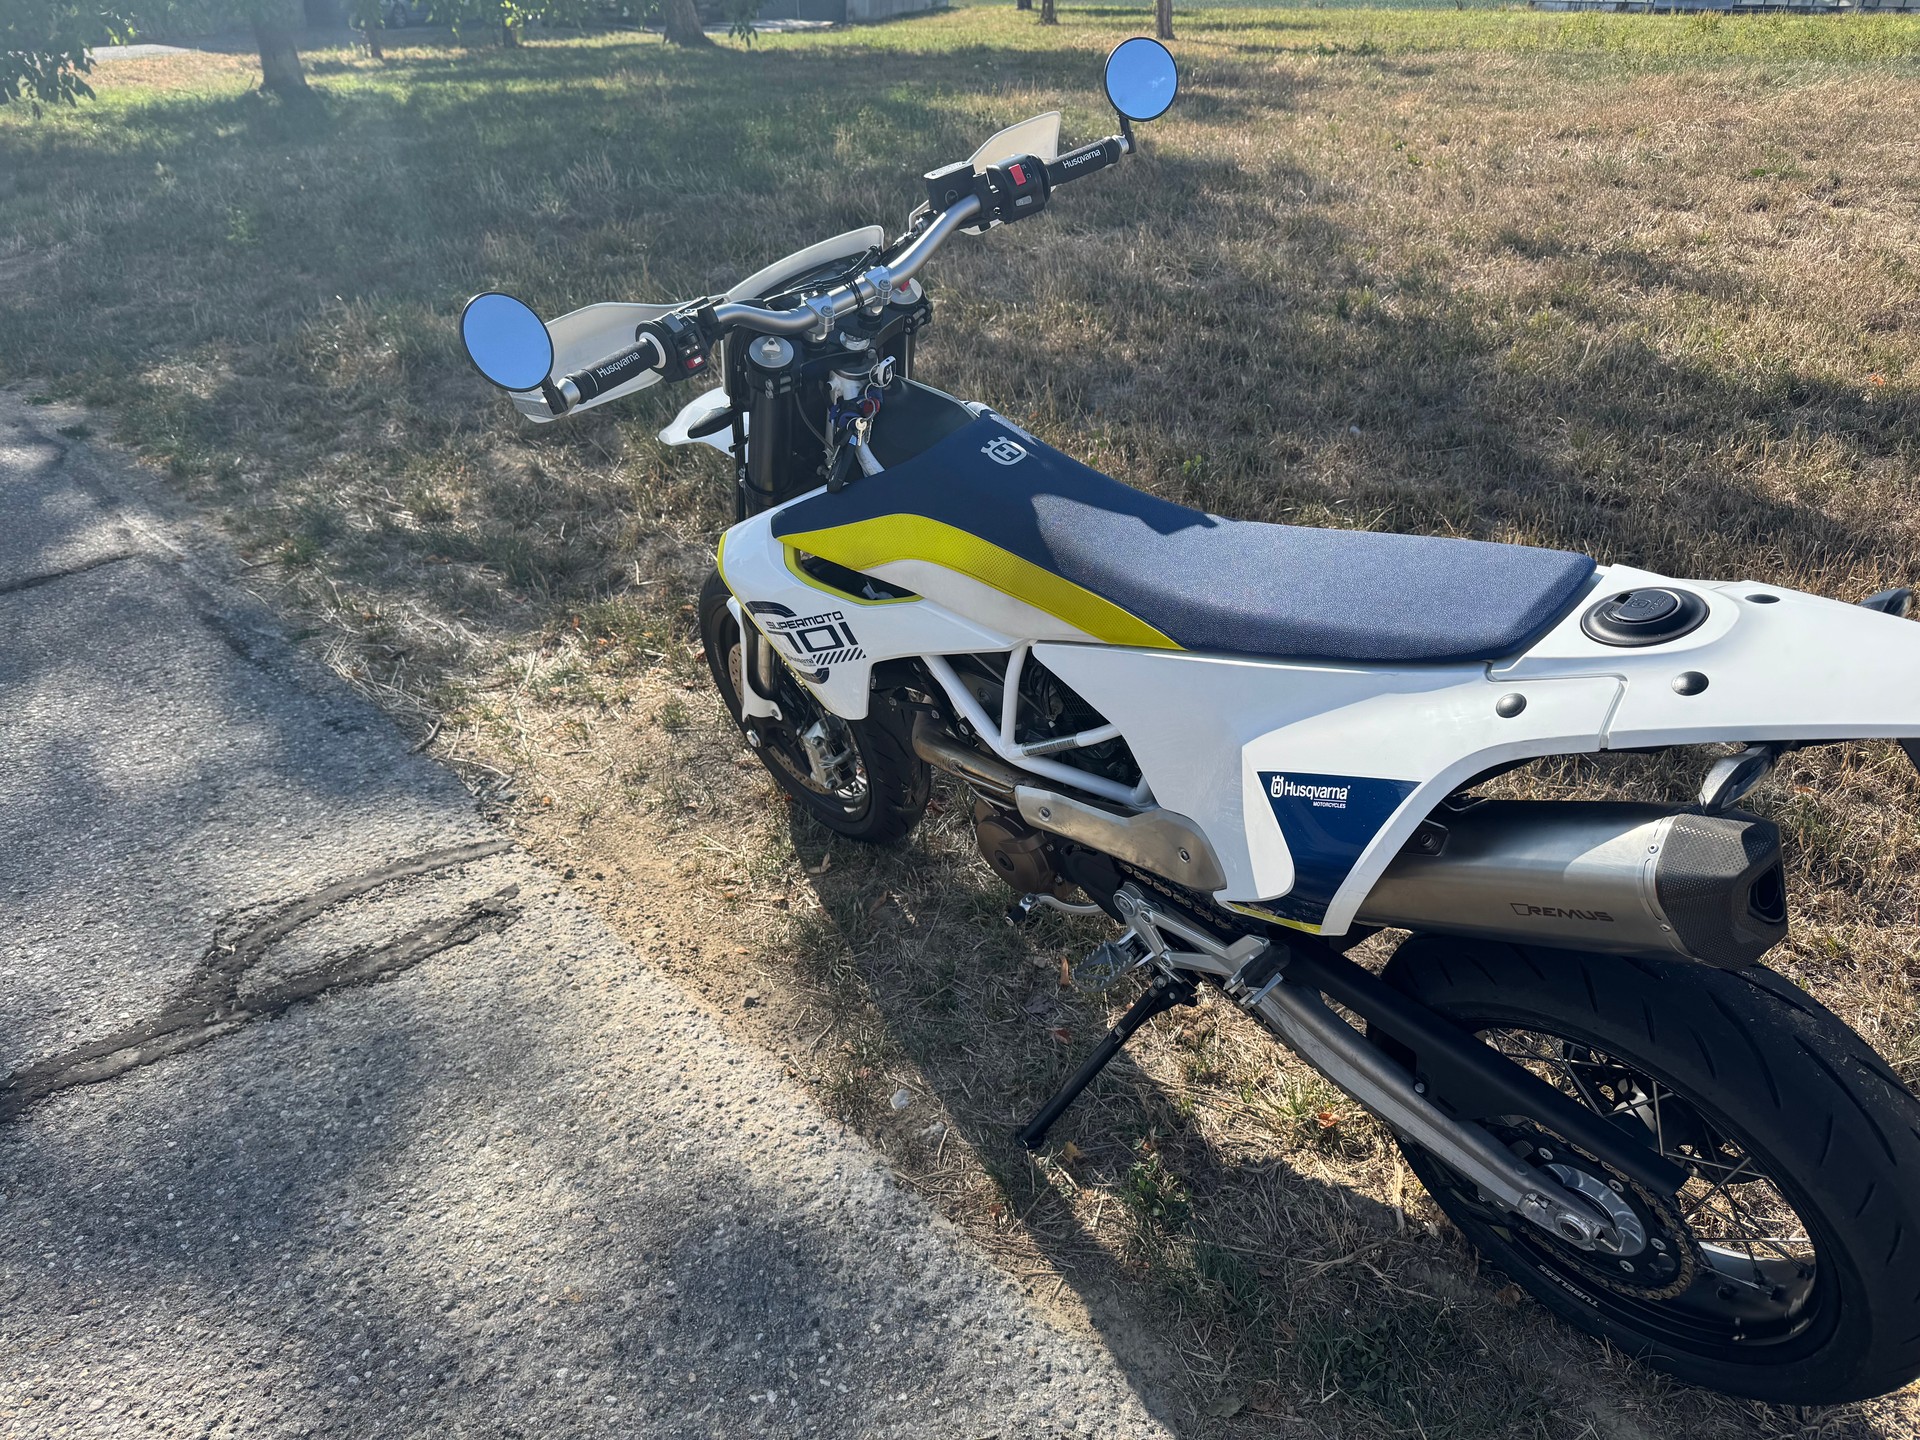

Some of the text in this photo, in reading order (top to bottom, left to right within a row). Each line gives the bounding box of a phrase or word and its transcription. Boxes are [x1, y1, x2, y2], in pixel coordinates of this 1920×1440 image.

[1062, 149, 1101, 169] Husqvarna
[596, 351, 641, 378] Husqvarna
[766, 610, 844, 629] SUPERMOTO
[1284, 781, 1348, 800] Husqvarna
[1313, 801, 1346, 809] MOTORCYCLES
[1528, 905, 1615, 922] REMUS
[1537, 1264, 1599, 1308] TUBELESS
